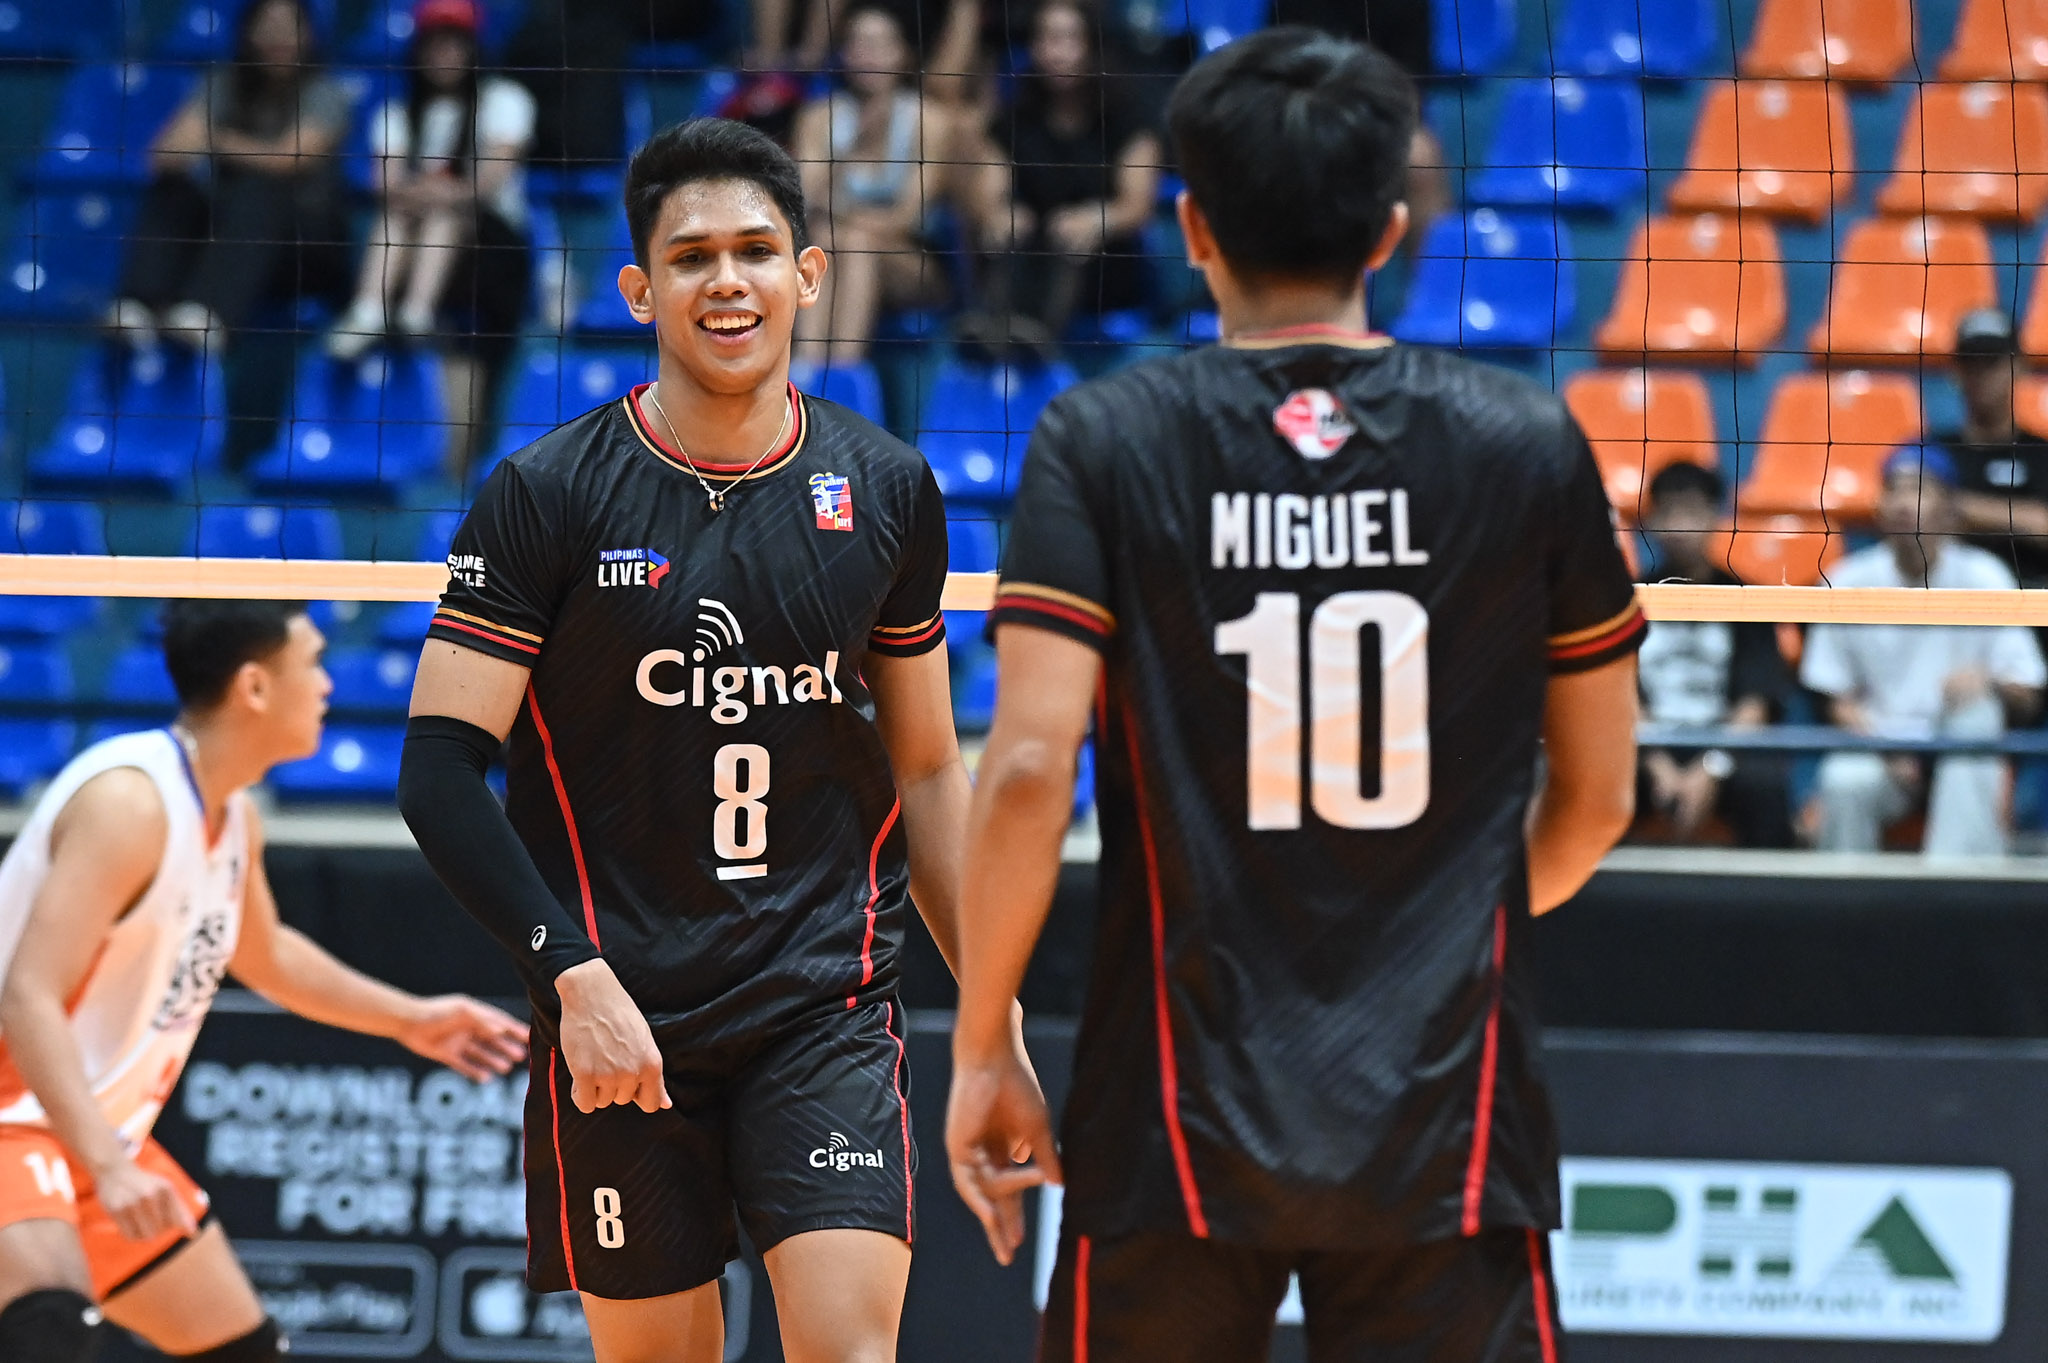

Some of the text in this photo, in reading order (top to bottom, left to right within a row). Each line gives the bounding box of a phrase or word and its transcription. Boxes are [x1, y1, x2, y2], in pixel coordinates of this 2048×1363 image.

[601, 549, 643, 562] PILIPINAS
[1211, 488, 1430, 569] MIGUEL
[597, 561, 646, 588] LIVE
[635, 648, 843, 724] Cignal
[1214, 590, 1431, 831] 10
[713, 743, 771, 860] 8
[808, 1147, 884, 1172] Cignal
[594, 1187, 626, 1249] 8
[1571, 1182, 1961, 1289] PHA
